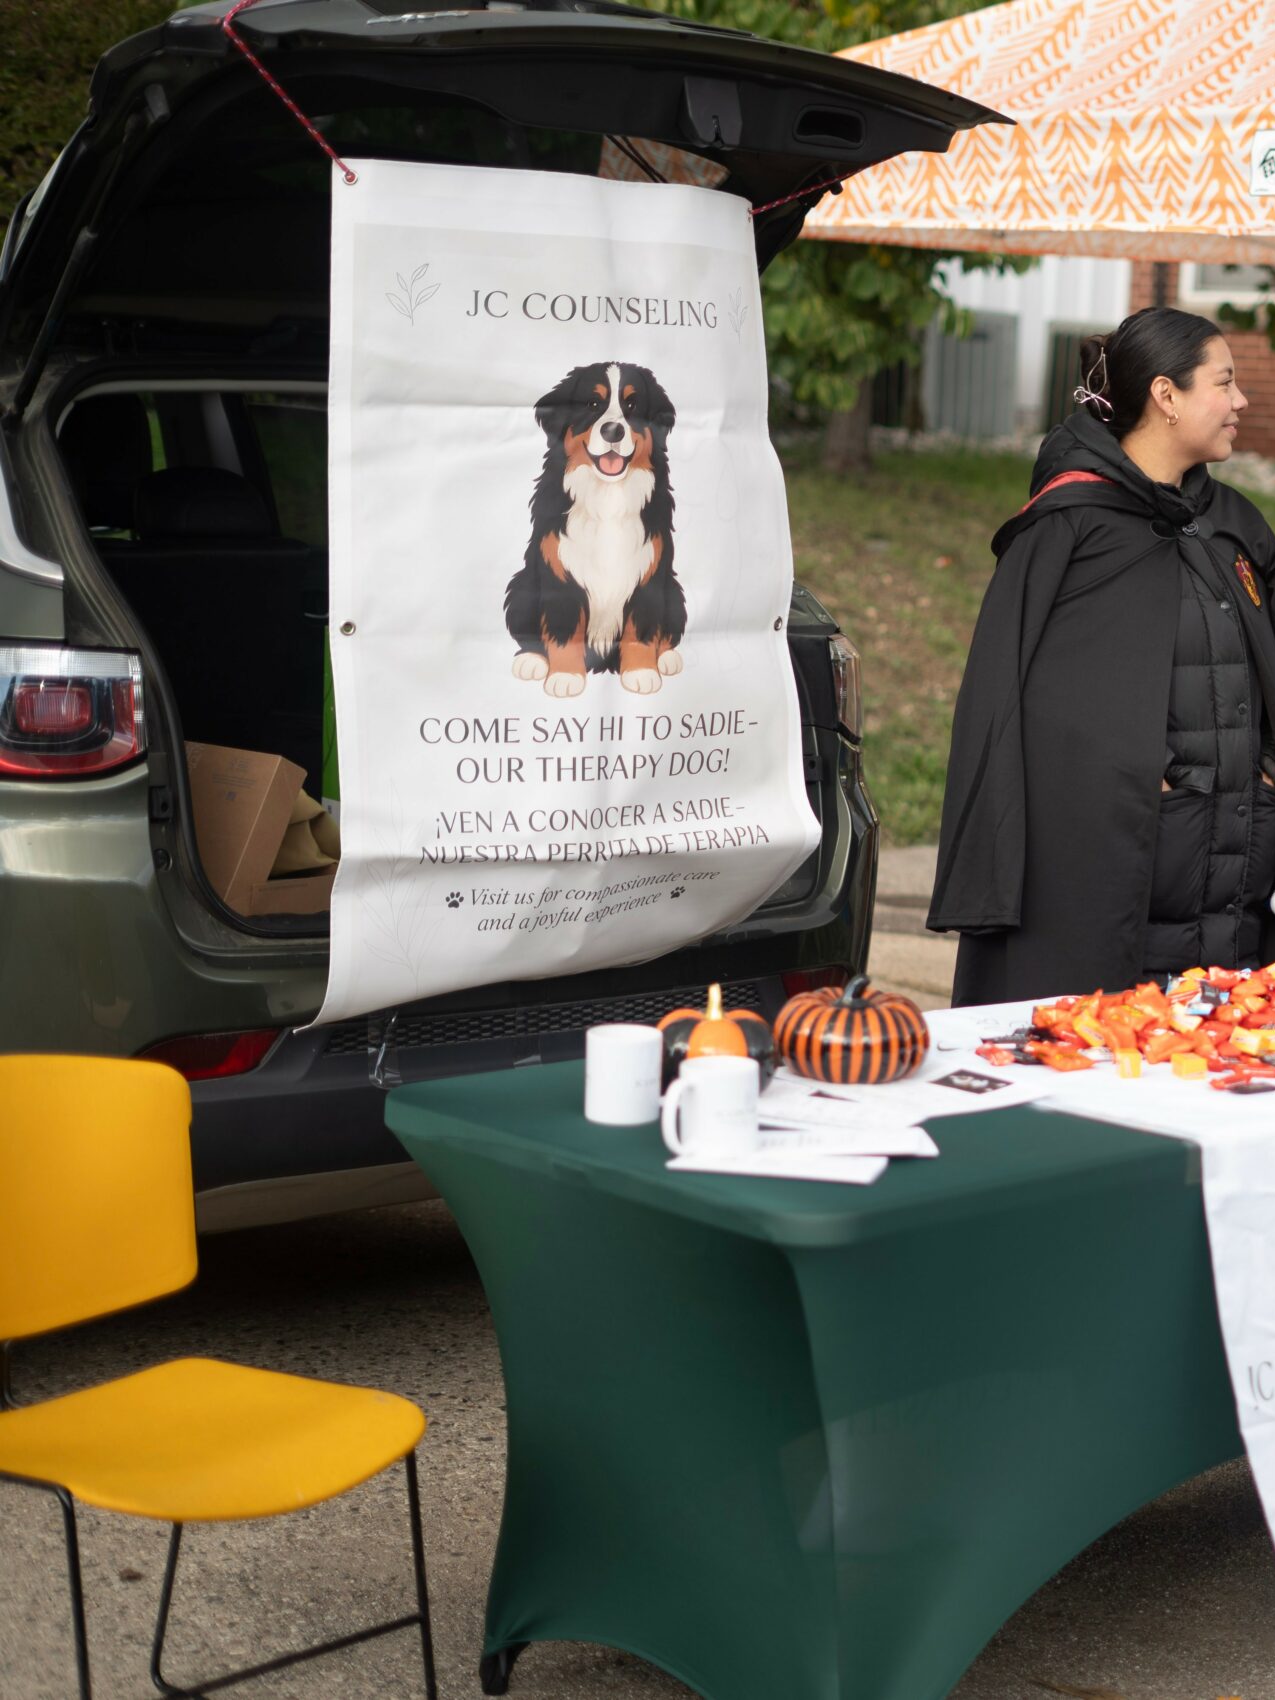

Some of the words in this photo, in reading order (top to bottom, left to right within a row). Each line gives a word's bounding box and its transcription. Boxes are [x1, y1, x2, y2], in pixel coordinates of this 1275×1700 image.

[466, 289, 510, 319] JC
[521, 291, 718, 329] COUNSELING
[419, 717, 521, 744] COME
[532, 716, 591, 743] SAY
[599, 715, 623, 742] HI
[635, 715, 672, 741] TO
[679, 709, 759, 739] SADIE-
[456, 756, 526, 784] OUR
[535, 752, 664, 783] THERAPY
[668, 747, 731, 777] DOG!
[435, 809, 494, 839] ¡VEN
[501, 809, 521, 833] A
[528, 803, 647, 833] CONOCER
[652, 802, 667, 825] A
[672, 796, 746, 823] SADIE-
[419, 844, 540, 865] NUESTRA
[548, 837, 641, 863] PERRITA
[646, 833, 677, 856] DE
[679, 823, 770, 852] TERAPIA
[470, 888, 510, 907] Visit
[514, 891, 535, 906] us
[533, 886, 563, 909] for
[564, 871, 683, 904] compassionate
[683, 869, 721, 881] care
[477, 912, 515, 932] and
[518, 917, 531, 930] a
[528, 906, 582, 933] joyful
[584, 891, 662, 922] experience
[1247, 1360, 1275, 1411] JC
